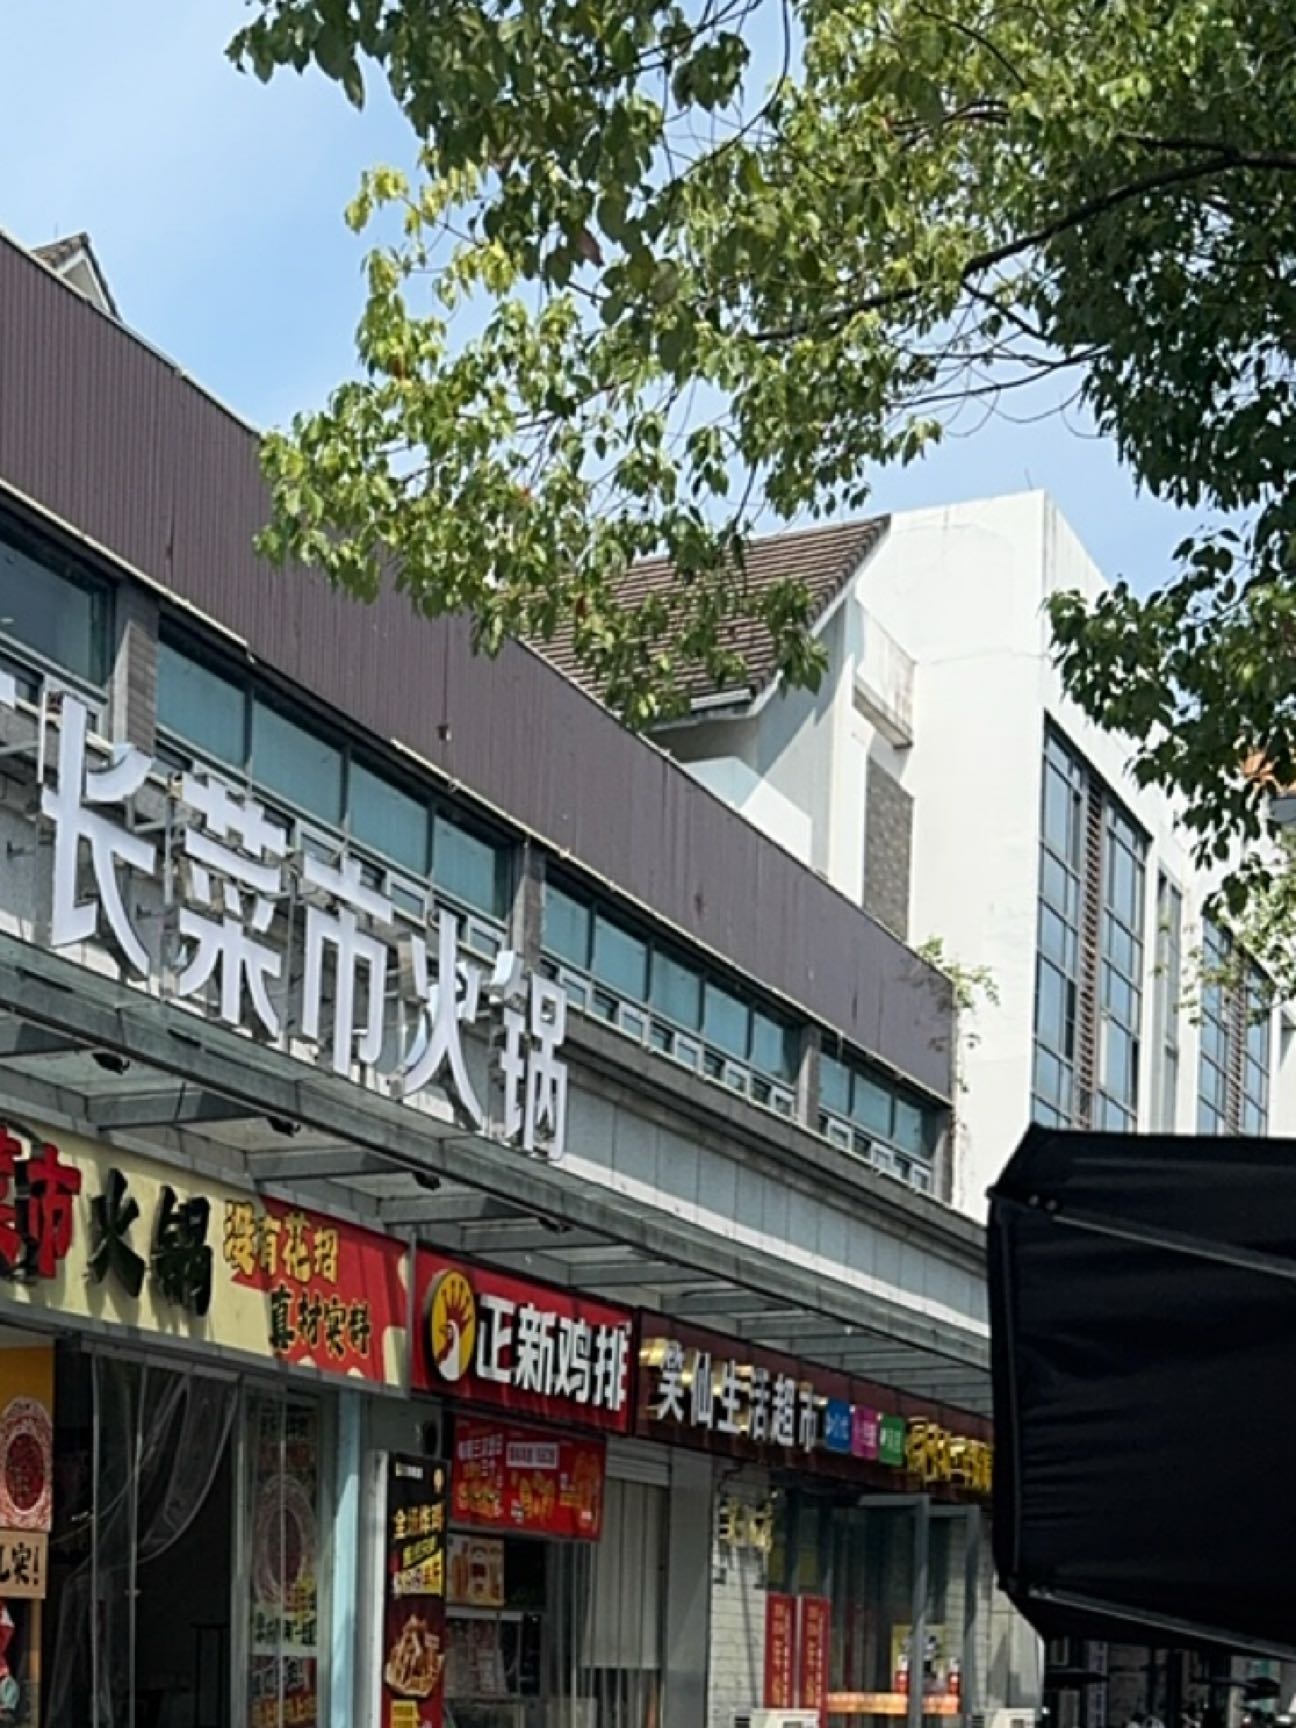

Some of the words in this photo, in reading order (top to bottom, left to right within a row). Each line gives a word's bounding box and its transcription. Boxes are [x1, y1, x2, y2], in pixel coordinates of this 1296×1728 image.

[268, 1280, 372, 1358] 真材实料
[475, 1293, 630, 1411] 正新鸡排
